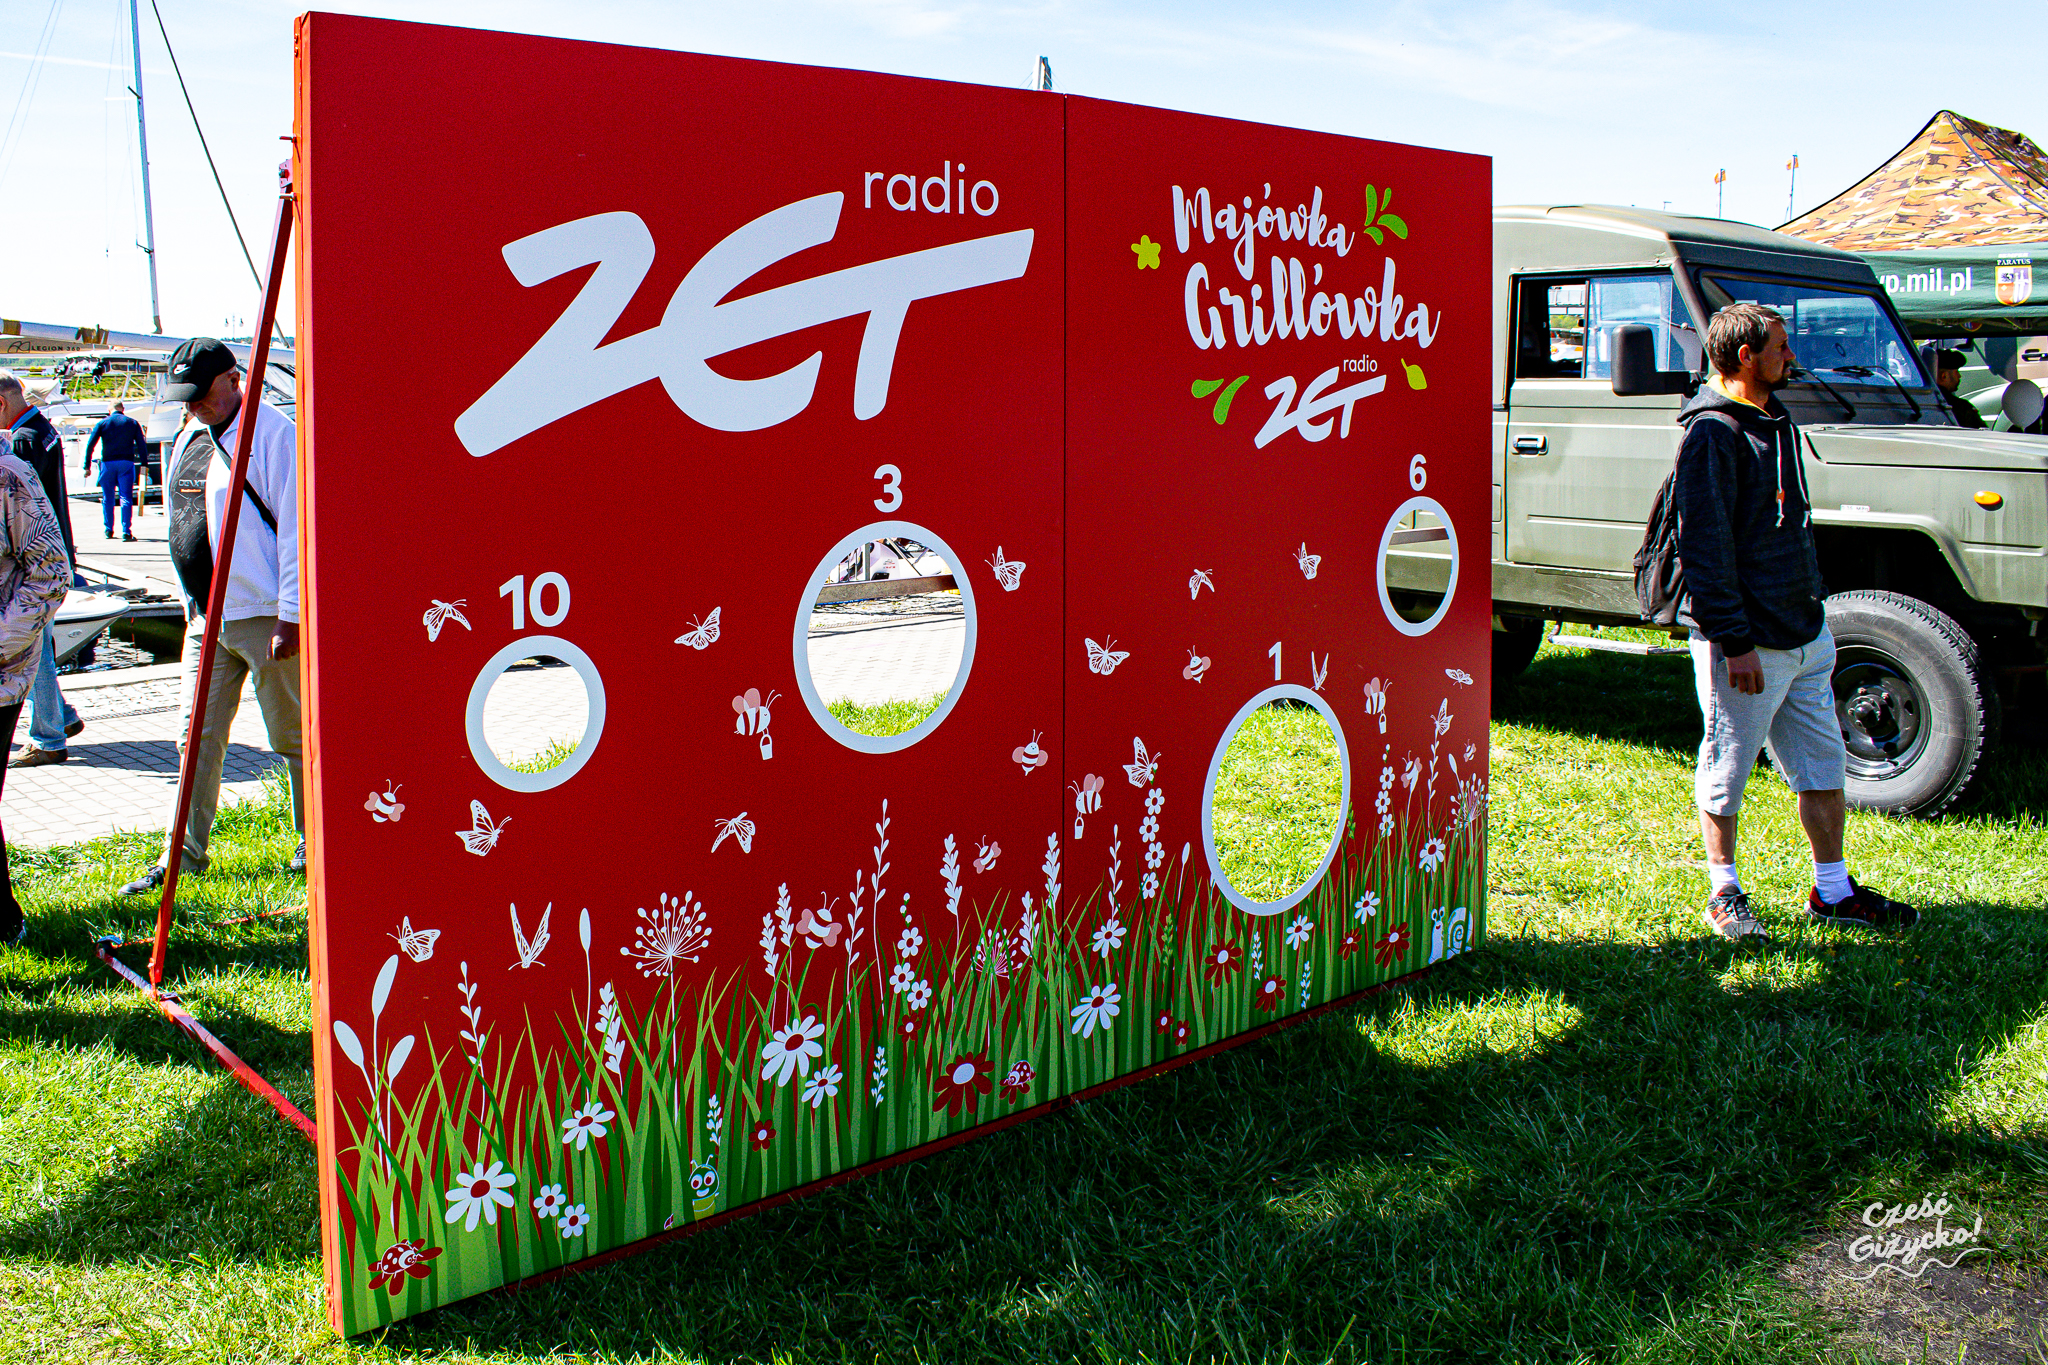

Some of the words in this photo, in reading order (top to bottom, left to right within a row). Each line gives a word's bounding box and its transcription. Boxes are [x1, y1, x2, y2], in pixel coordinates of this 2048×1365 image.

[864, 160, 1000, 217] radio
[1171, 182, 1356, 281] Majówka
[453, 190, 1035, 458] ZET
[1184, 255, 1442, 350] Grillówka
[1343, 354, 1378, 373] radio
[1254, 366, 1387, 450] ZET
[873, 463, 903, 513] 3
[1409, 453, 1427, 492] 6
[499, 571, 571, 631] 10
[1268, 641, 1282, 682] 1
